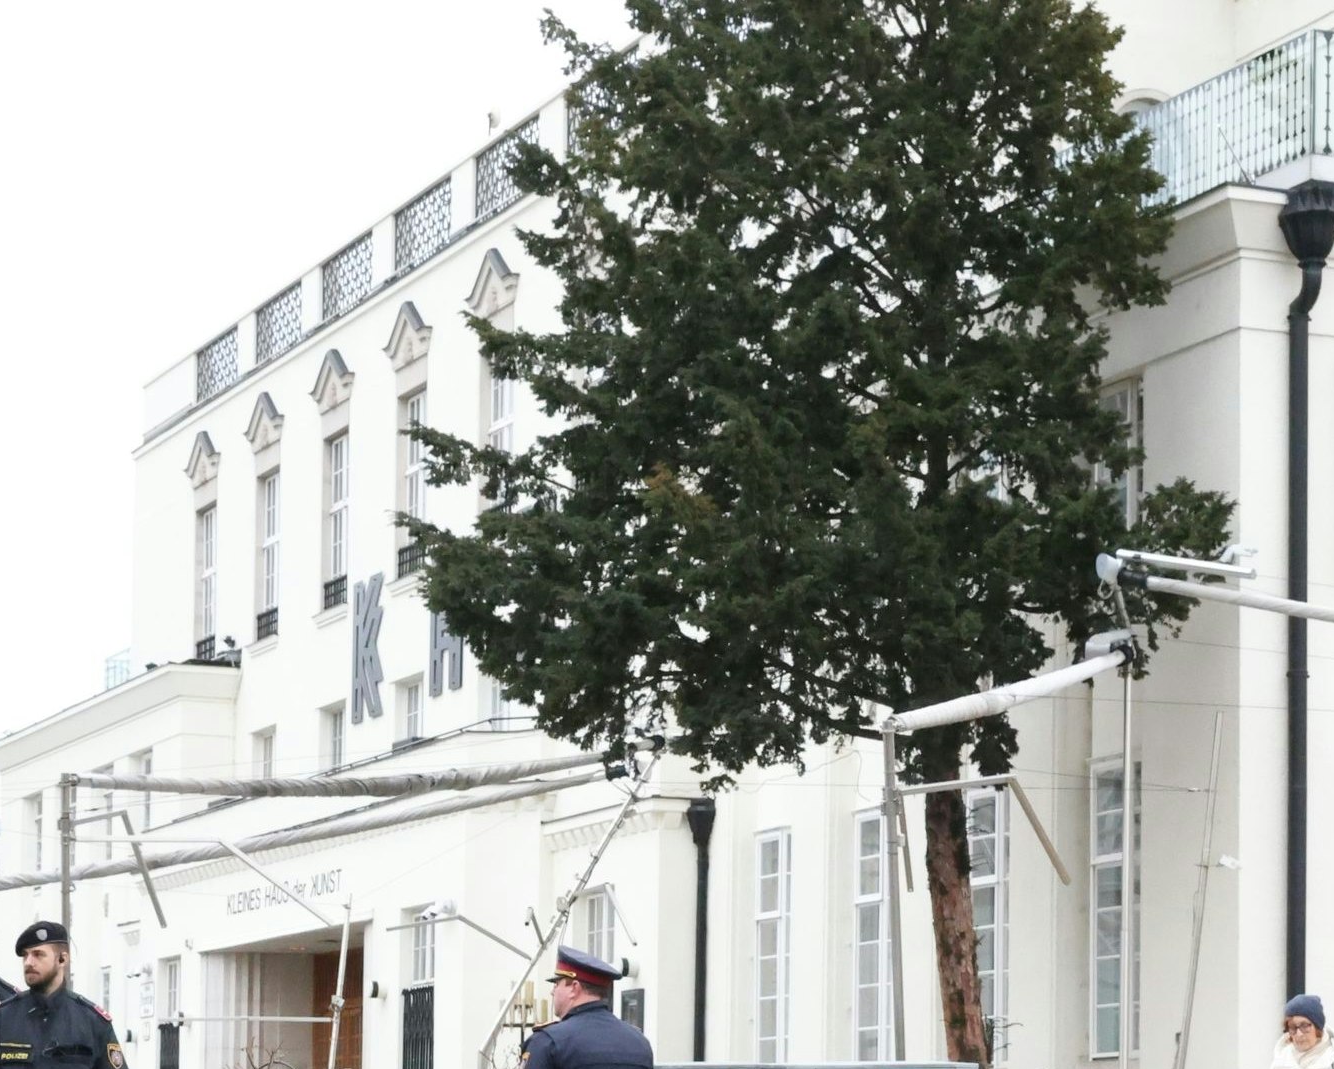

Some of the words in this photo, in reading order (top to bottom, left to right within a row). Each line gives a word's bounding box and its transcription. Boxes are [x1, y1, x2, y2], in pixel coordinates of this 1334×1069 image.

[227, 887, 261, 915] KLEINES
[265, 880, 289, 908] HAUS
[293, 879, 307, 899] der
[310, 868, 343, 898] KUNST
